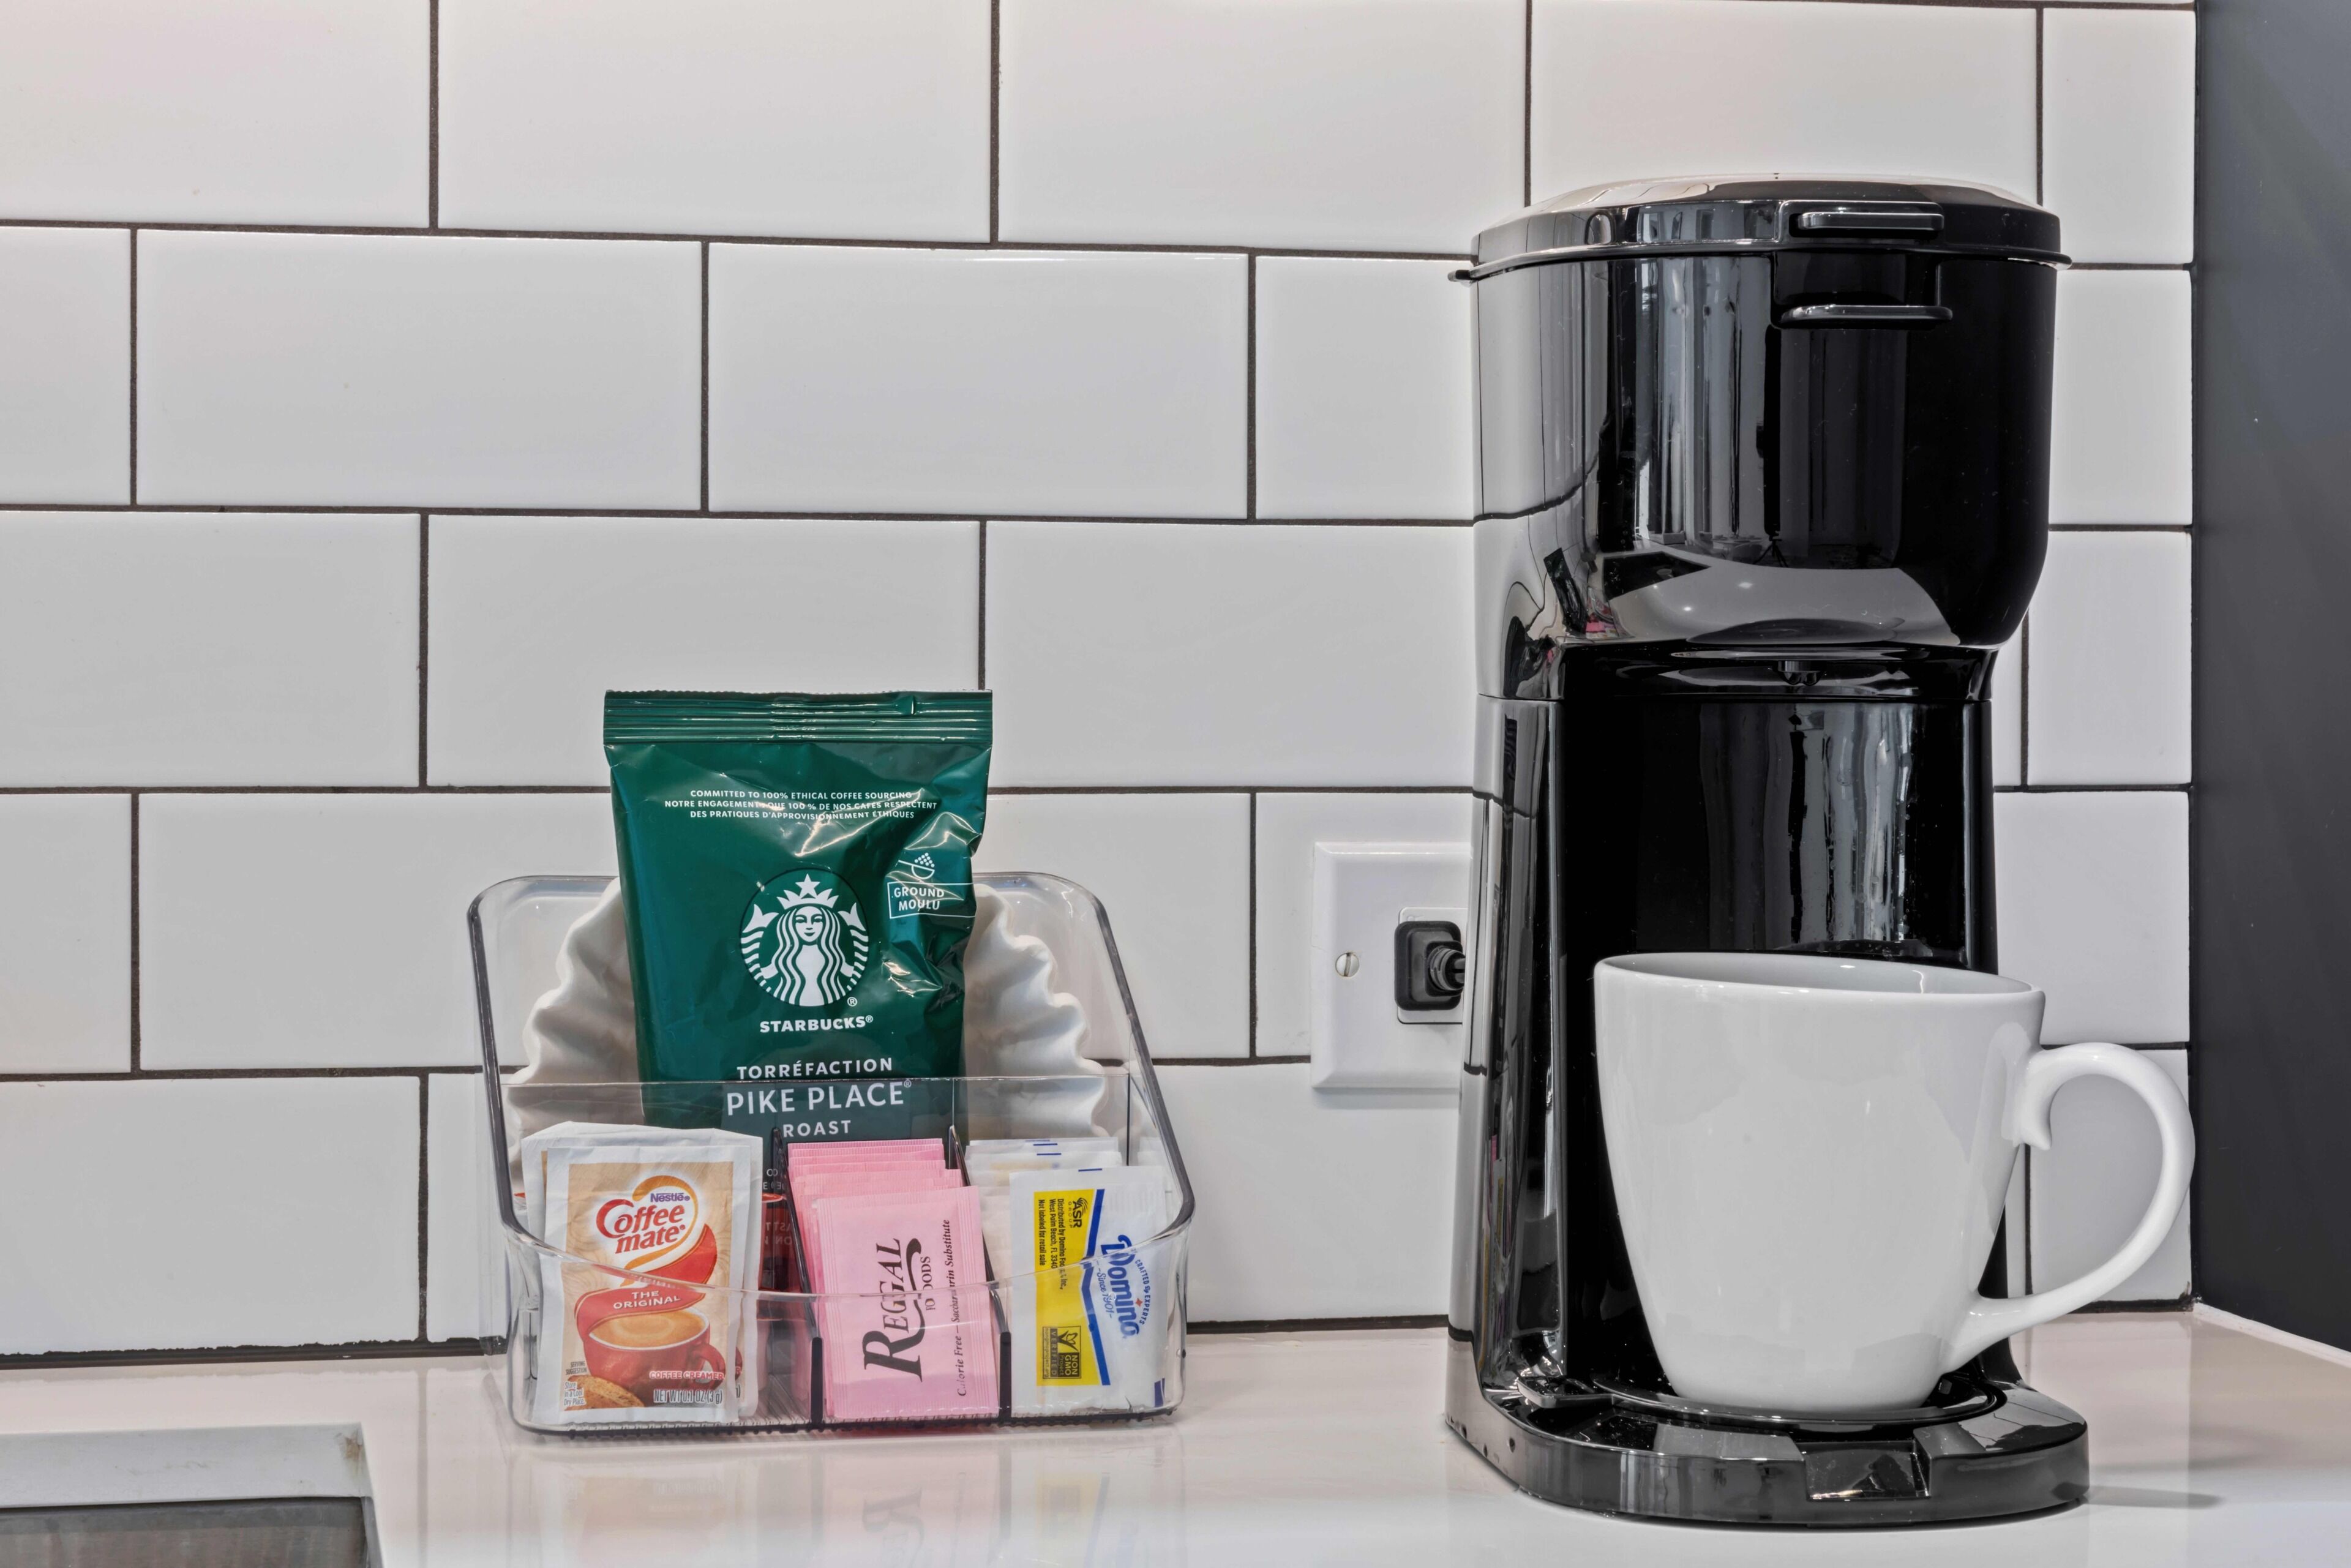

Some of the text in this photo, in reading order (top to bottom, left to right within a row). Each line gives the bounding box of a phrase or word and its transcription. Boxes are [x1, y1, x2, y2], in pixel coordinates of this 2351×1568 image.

[872, 809, 915, 819] ÉTHIQUES
[894, 887, 945, 898] GROUND
[899, 899, 940, 912] MOULU
[737, 1058, 893, 1079] TORRÉFACTION
[727, 1089, 795, 1116] PIKE
[783, 1120, 852, 1138] ROAST
[596, 1199, 685, 1239] Coffee
[1073, 1201, 1082, 1228] ASR
[942, 1220, 953, 1270] Substitute
[1135, 1259, 1150, 1285] CRAFTED
[632, 1291, 659, 1299] THE
[1100, 1234, 1140, 1337] Domino
[613, 1296, 681, 1309] ORIGINAL
[1139, 1295, 1151, 1325] EXPERTS
[954, 1336, 964, 1356] Free
[650, 1371, 682, 1379] COFFEE
[683, 1371, 725, 1381] CREAMER
[955, 1360, 966, 1397] Clorie
[654, 1389, 667, 1403] NET
[670, 1389, 681, 1403] WT
